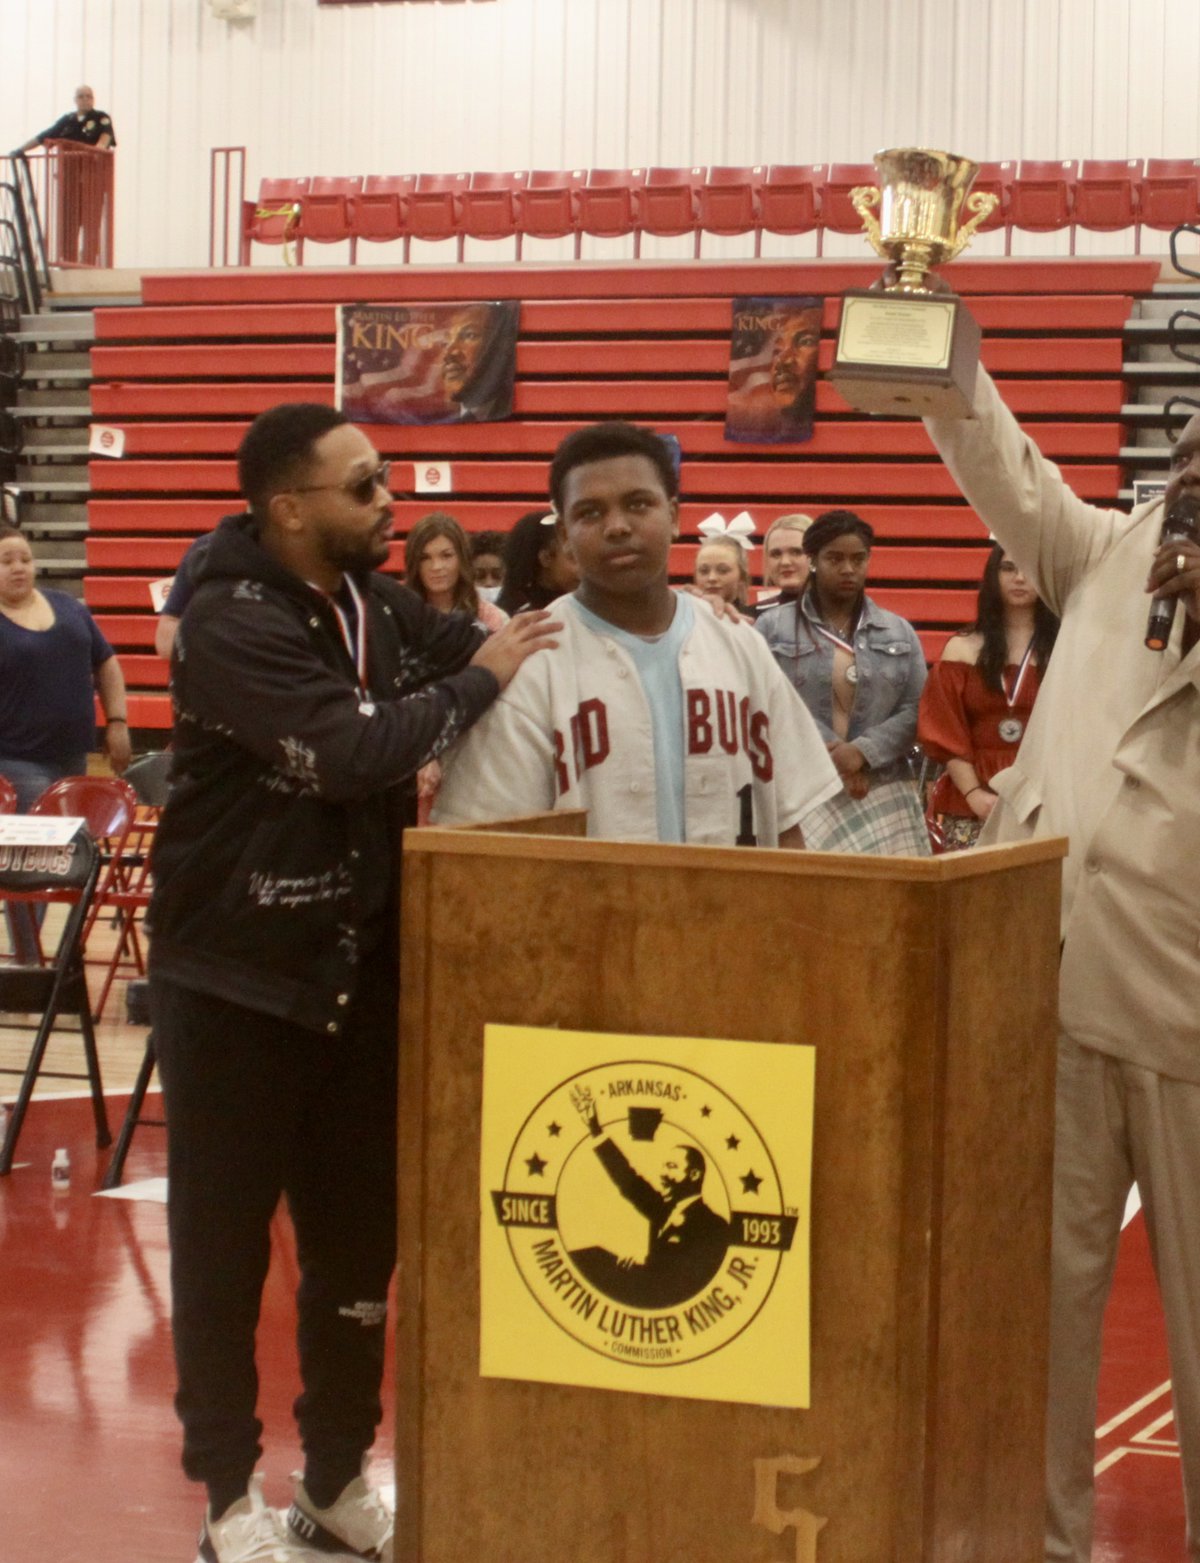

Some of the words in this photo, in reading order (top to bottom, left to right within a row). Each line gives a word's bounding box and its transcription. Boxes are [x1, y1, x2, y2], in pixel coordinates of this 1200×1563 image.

[738, 313, 784, 331] KING
[352, 322, 435, 350] KING
[607, 1079, 682, 1102] ARKANSAS
[502, 1197, 549, 1224] SINCE
[742, 1217, 781, 1244] 1993
[531, 1238, 599, 1321] MARTIN
[598, 1309, 683, 1344] LUTHER
[685, 1286, 743, 1335] KING,
[726, 1254, 760, 1290] JR.
[611, 1340, 673, 1360] COMMISSION
